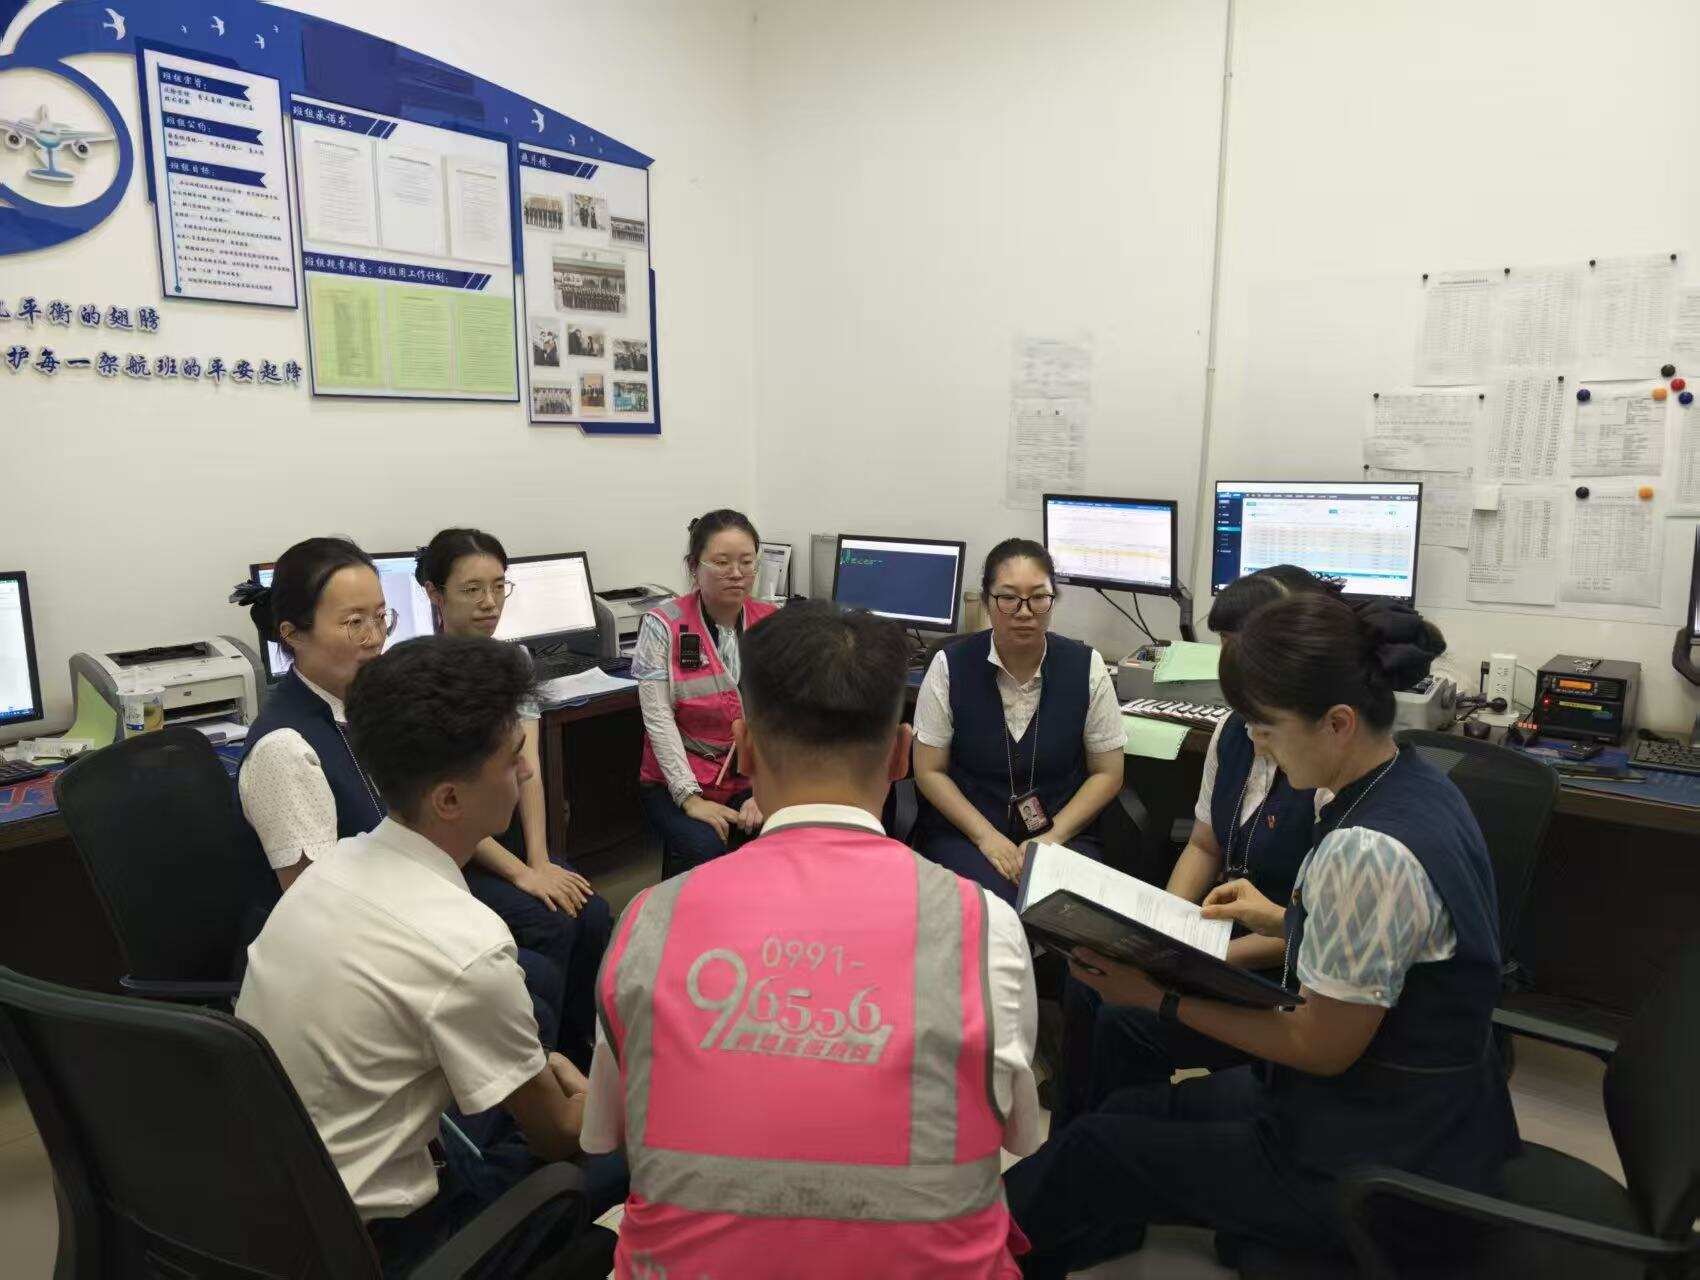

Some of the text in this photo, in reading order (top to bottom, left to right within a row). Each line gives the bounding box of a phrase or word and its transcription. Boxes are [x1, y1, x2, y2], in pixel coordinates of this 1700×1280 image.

[6, 346, 303, 382] 护每一架航班的平安起降
[762, 935, 865, 976] 0991-
